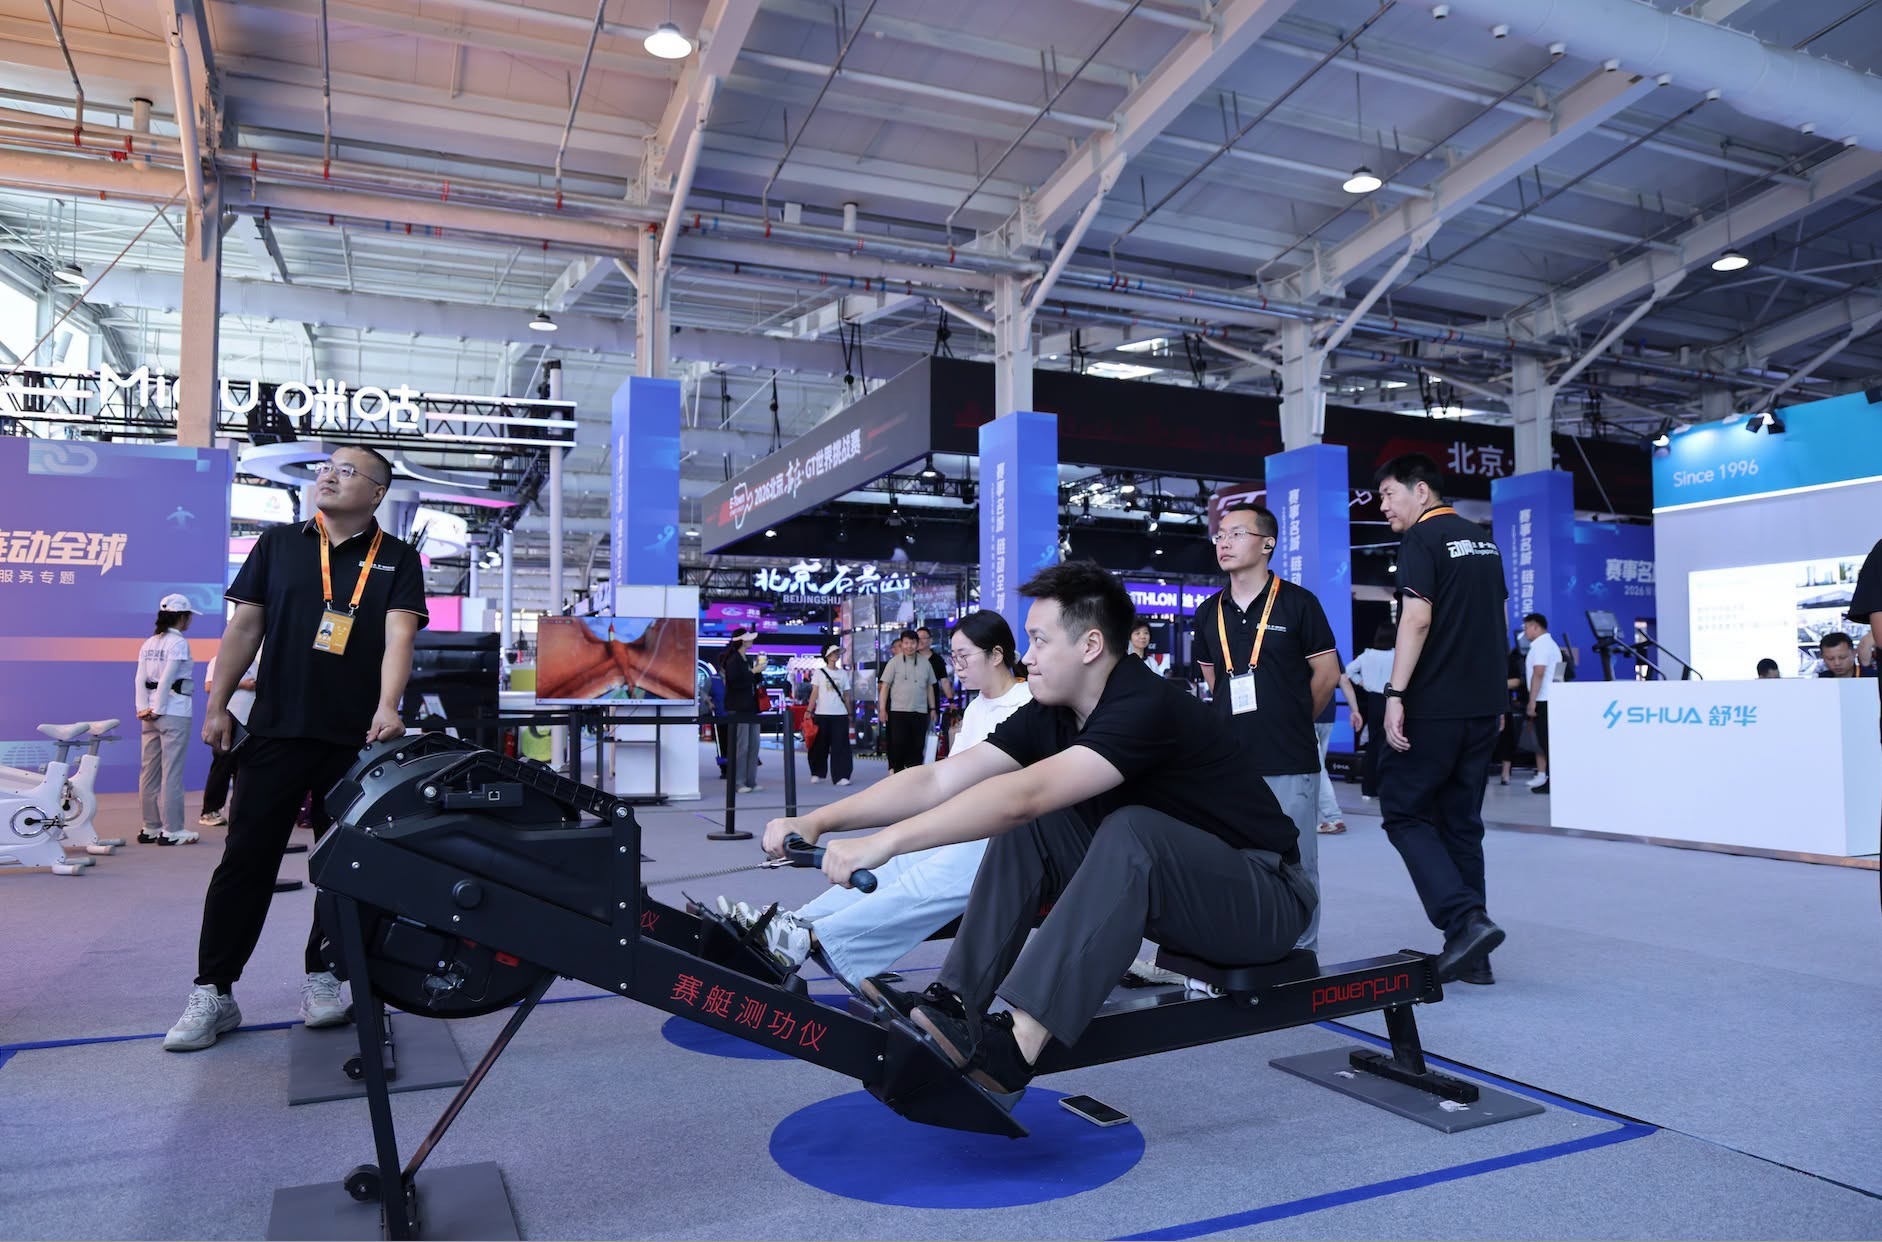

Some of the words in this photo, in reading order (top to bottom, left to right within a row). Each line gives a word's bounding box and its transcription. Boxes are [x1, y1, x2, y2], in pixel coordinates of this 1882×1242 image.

[275, 378, 420, 428] 咪咕
[1673, 470, 1715, 488] Since
[1718, 459, 1759, 480] 1996
[0, 529, 128, 576] 动全球
[0, 570, 75, 585] 服务专题
[1606, 558, 1655, 583] 赛事名
[1627, 706, 1703, 724] SHUA
[1709, 705, 1757, 727] 舒华
[1312, 973, 1409, 1014] powerfun
[669, 973, 828, 1052] 赛艇测功仪
